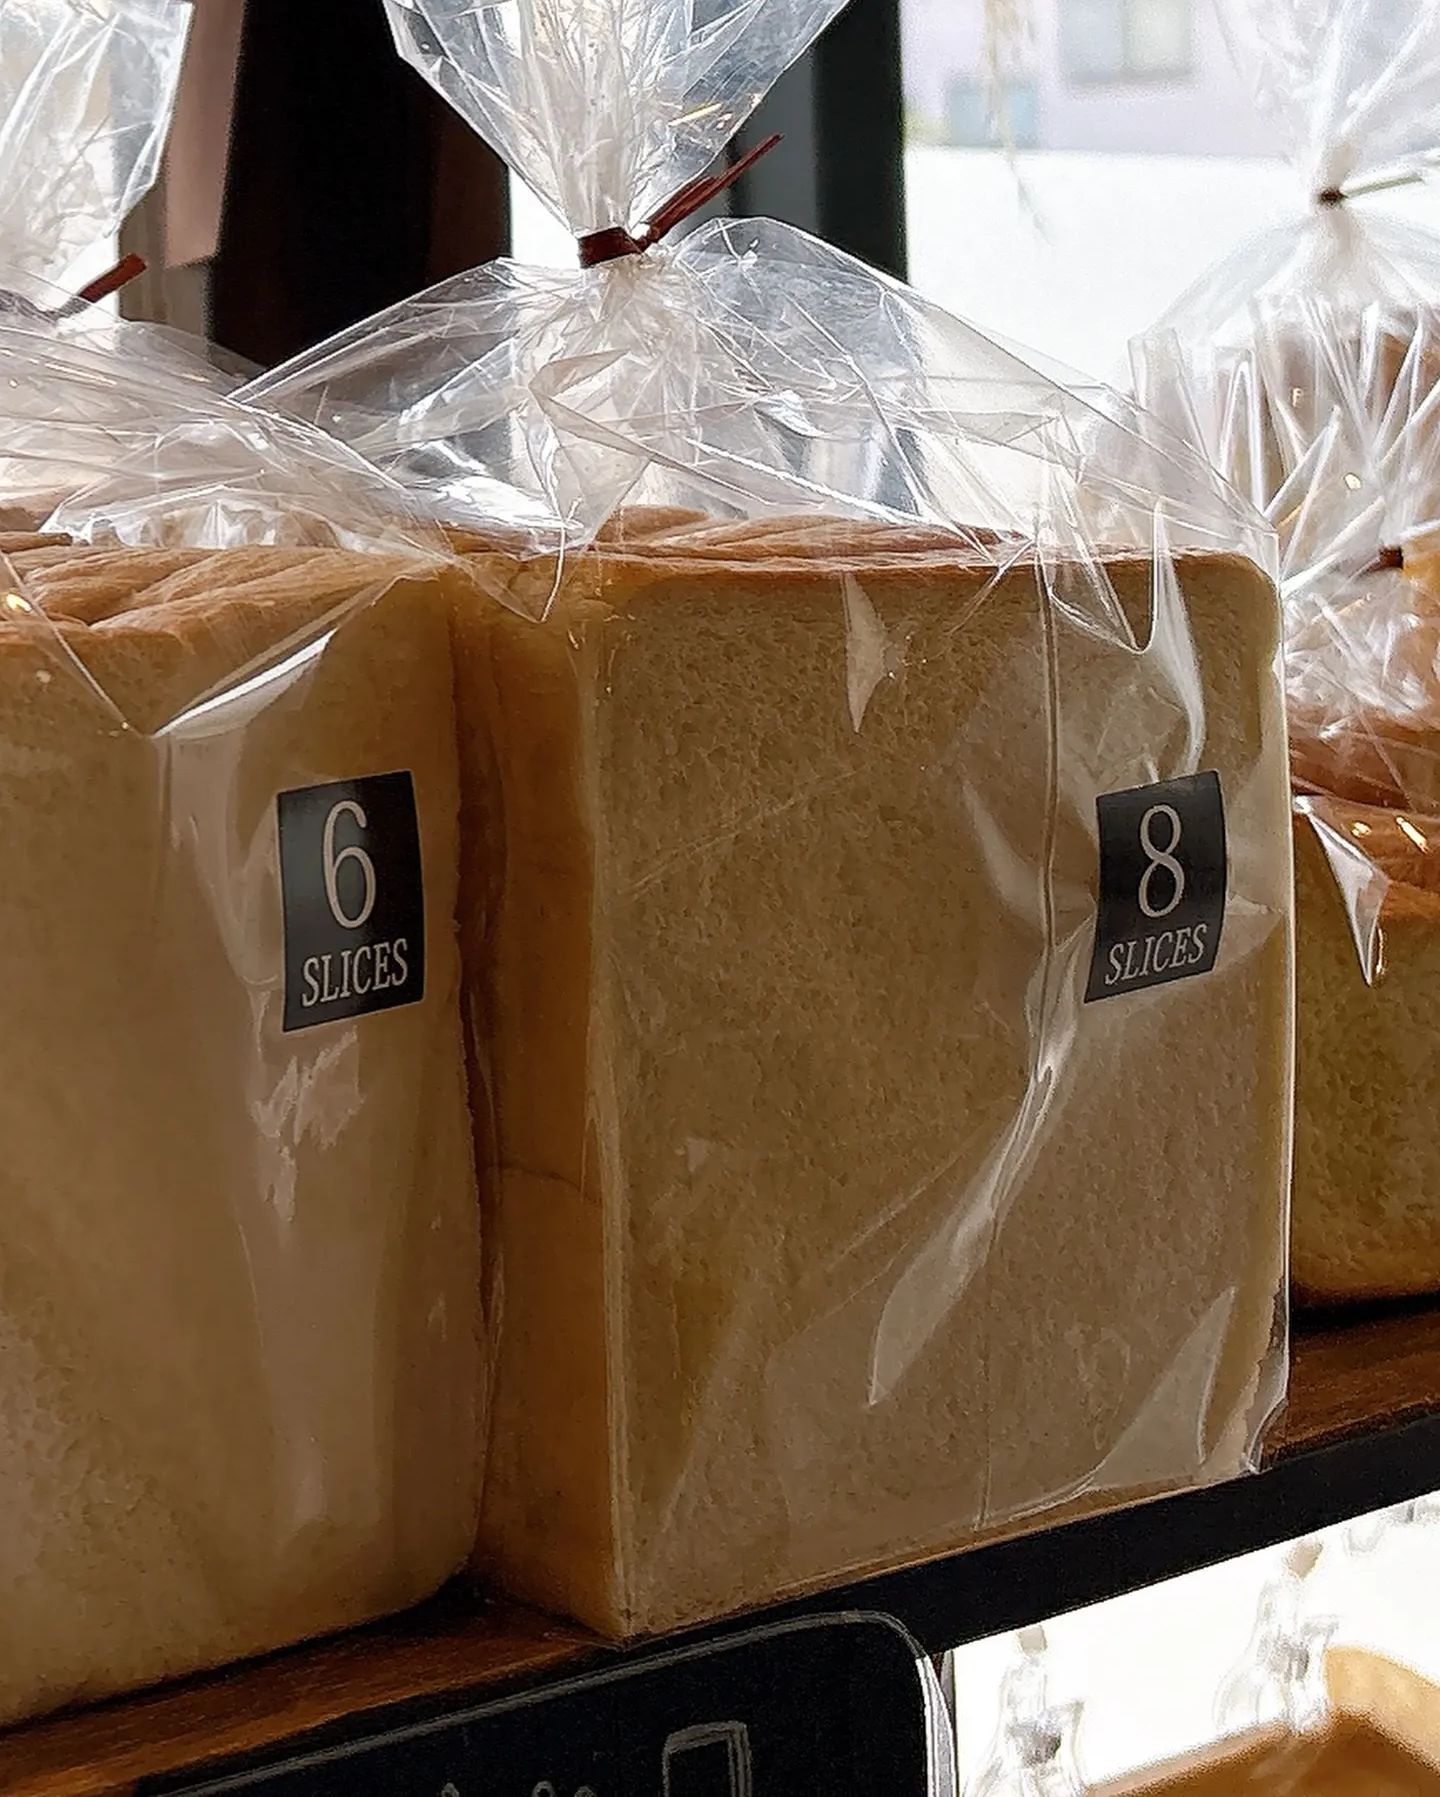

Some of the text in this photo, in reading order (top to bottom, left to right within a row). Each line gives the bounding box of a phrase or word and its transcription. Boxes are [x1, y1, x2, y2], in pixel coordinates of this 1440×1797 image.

[324, 800, 376, 928] 6
[1138, 805, 1185, 917] 8
[301, 938, 408, 1007] SLICES
[1104, 924, 1207, 984] SLICES
